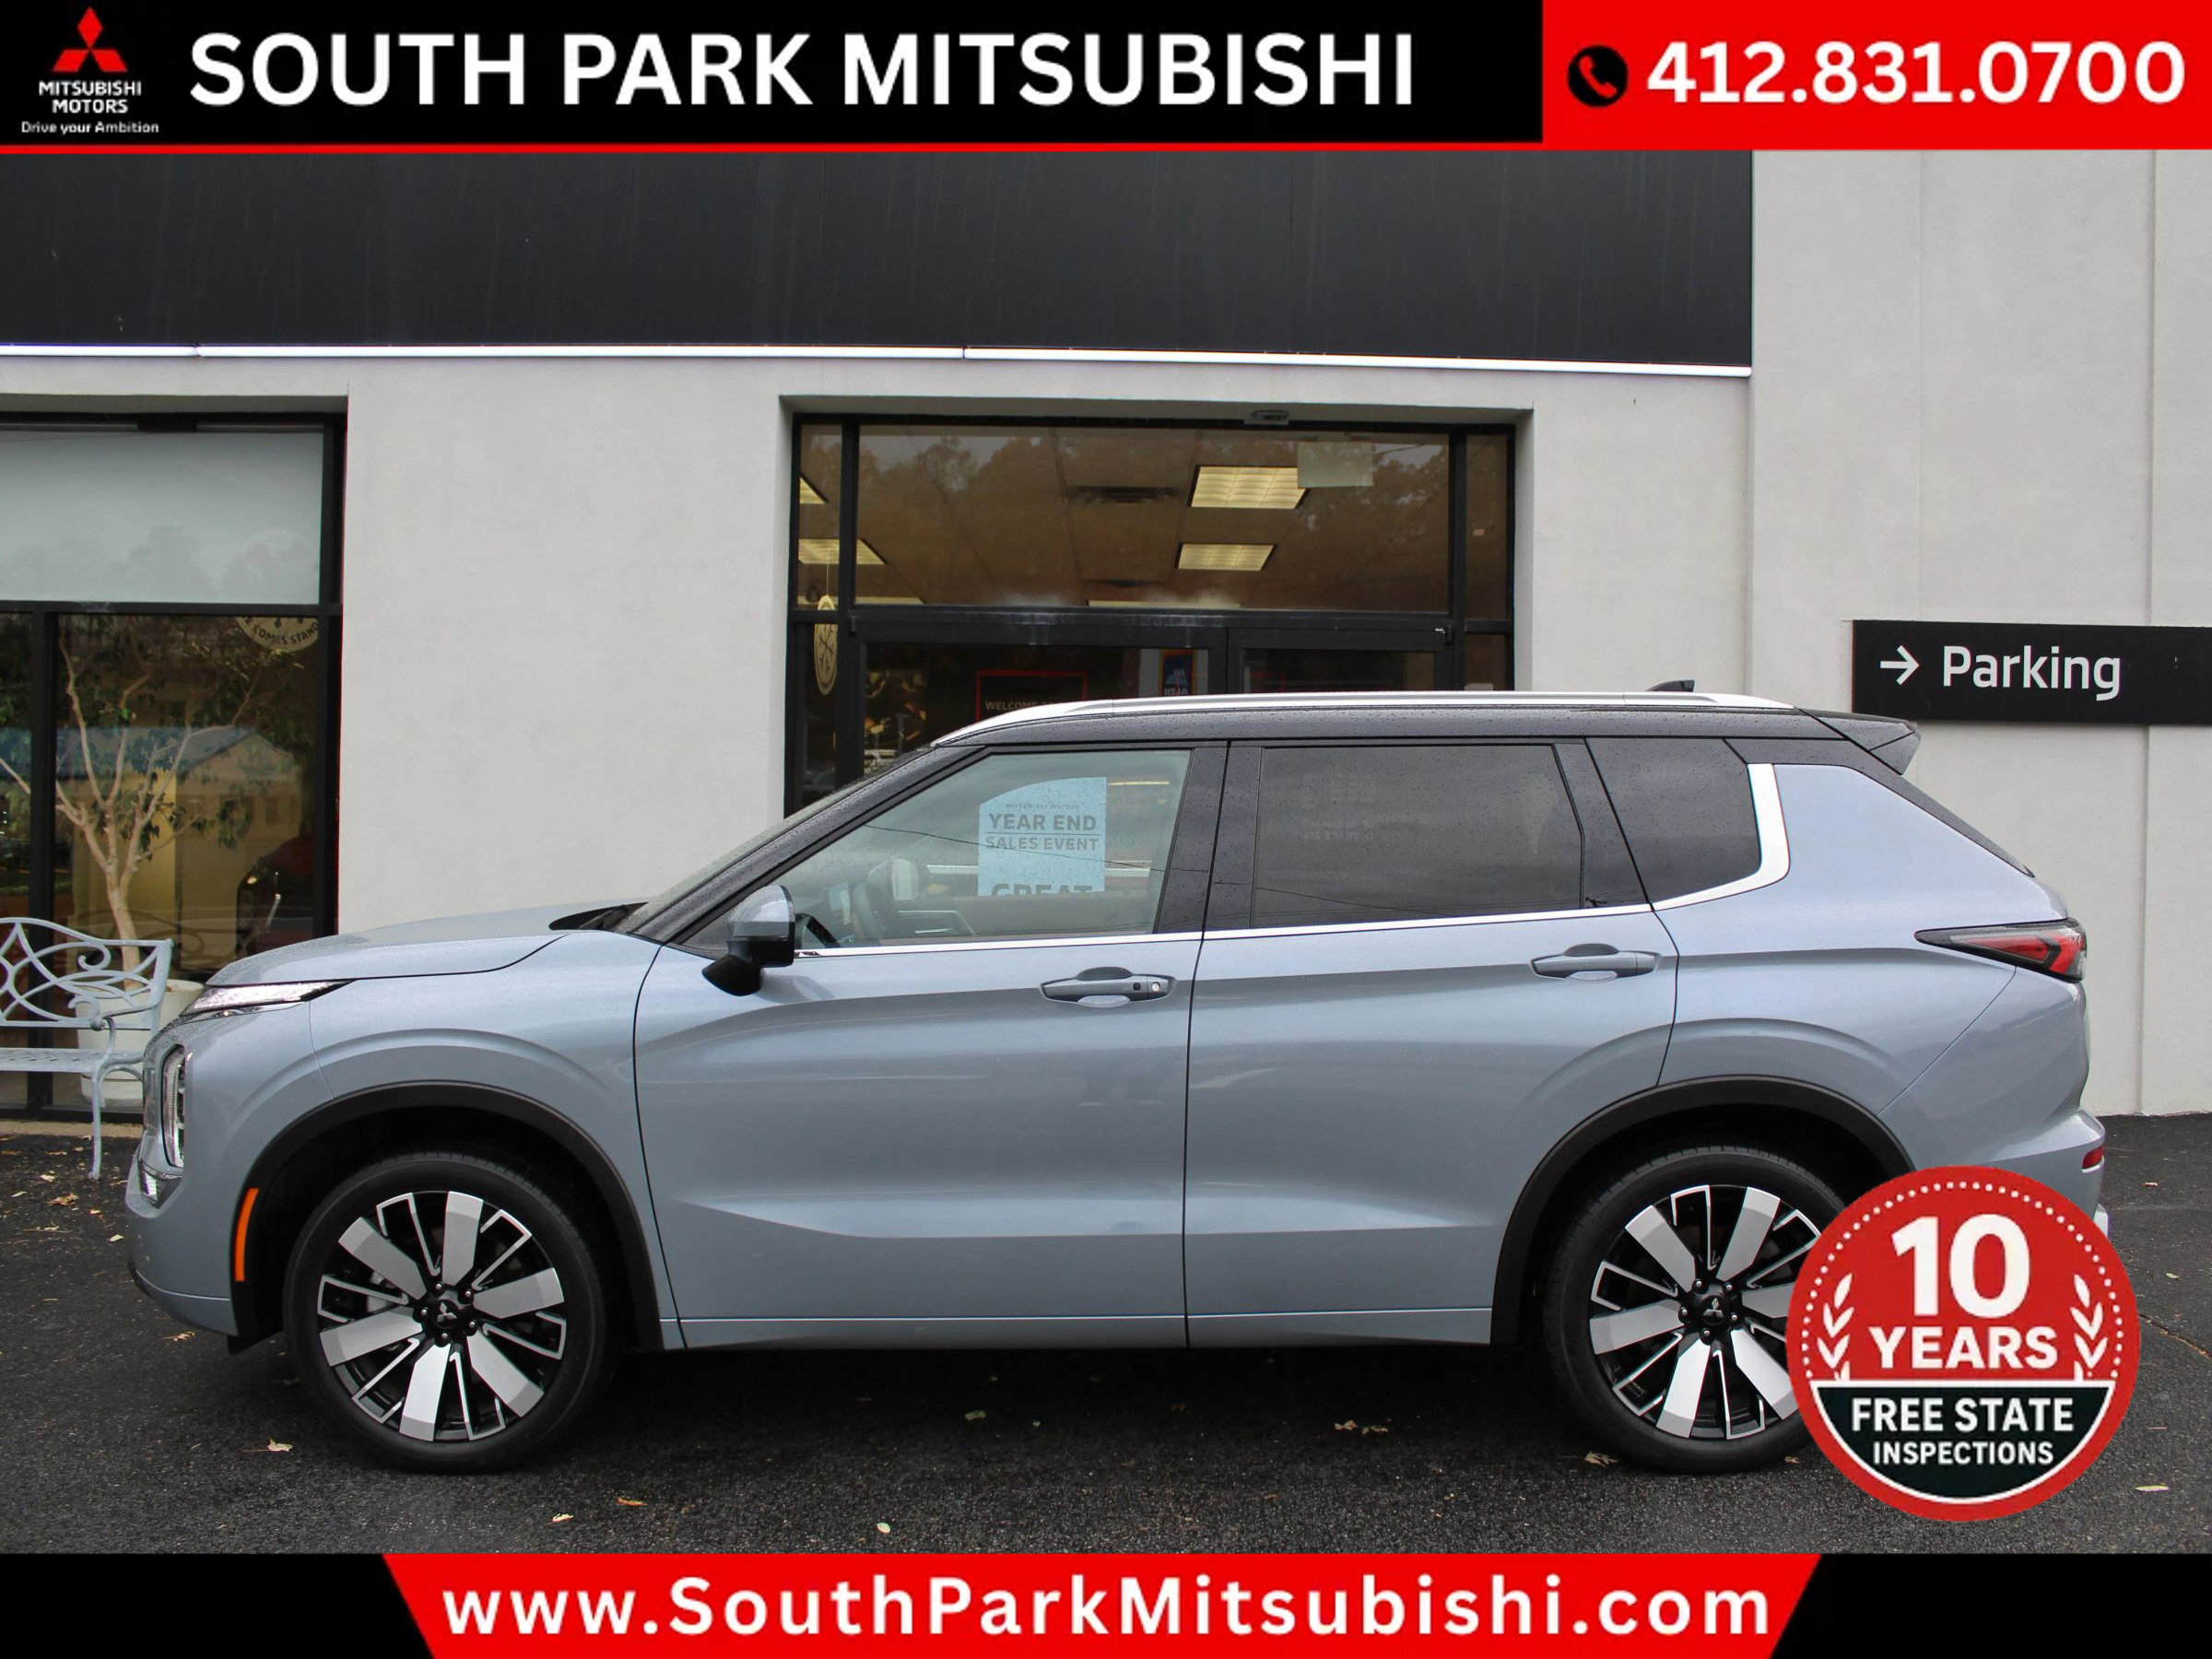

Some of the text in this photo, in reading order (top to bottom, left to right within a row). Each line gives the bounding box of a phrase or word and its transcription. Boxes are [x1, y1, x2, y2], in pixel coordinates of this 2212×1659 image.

[1943, 645, 2121, 701] Parking
[988, 813, 1097, 831] YEAR END
[985, 835, 1100, 852] SALES EVENT
